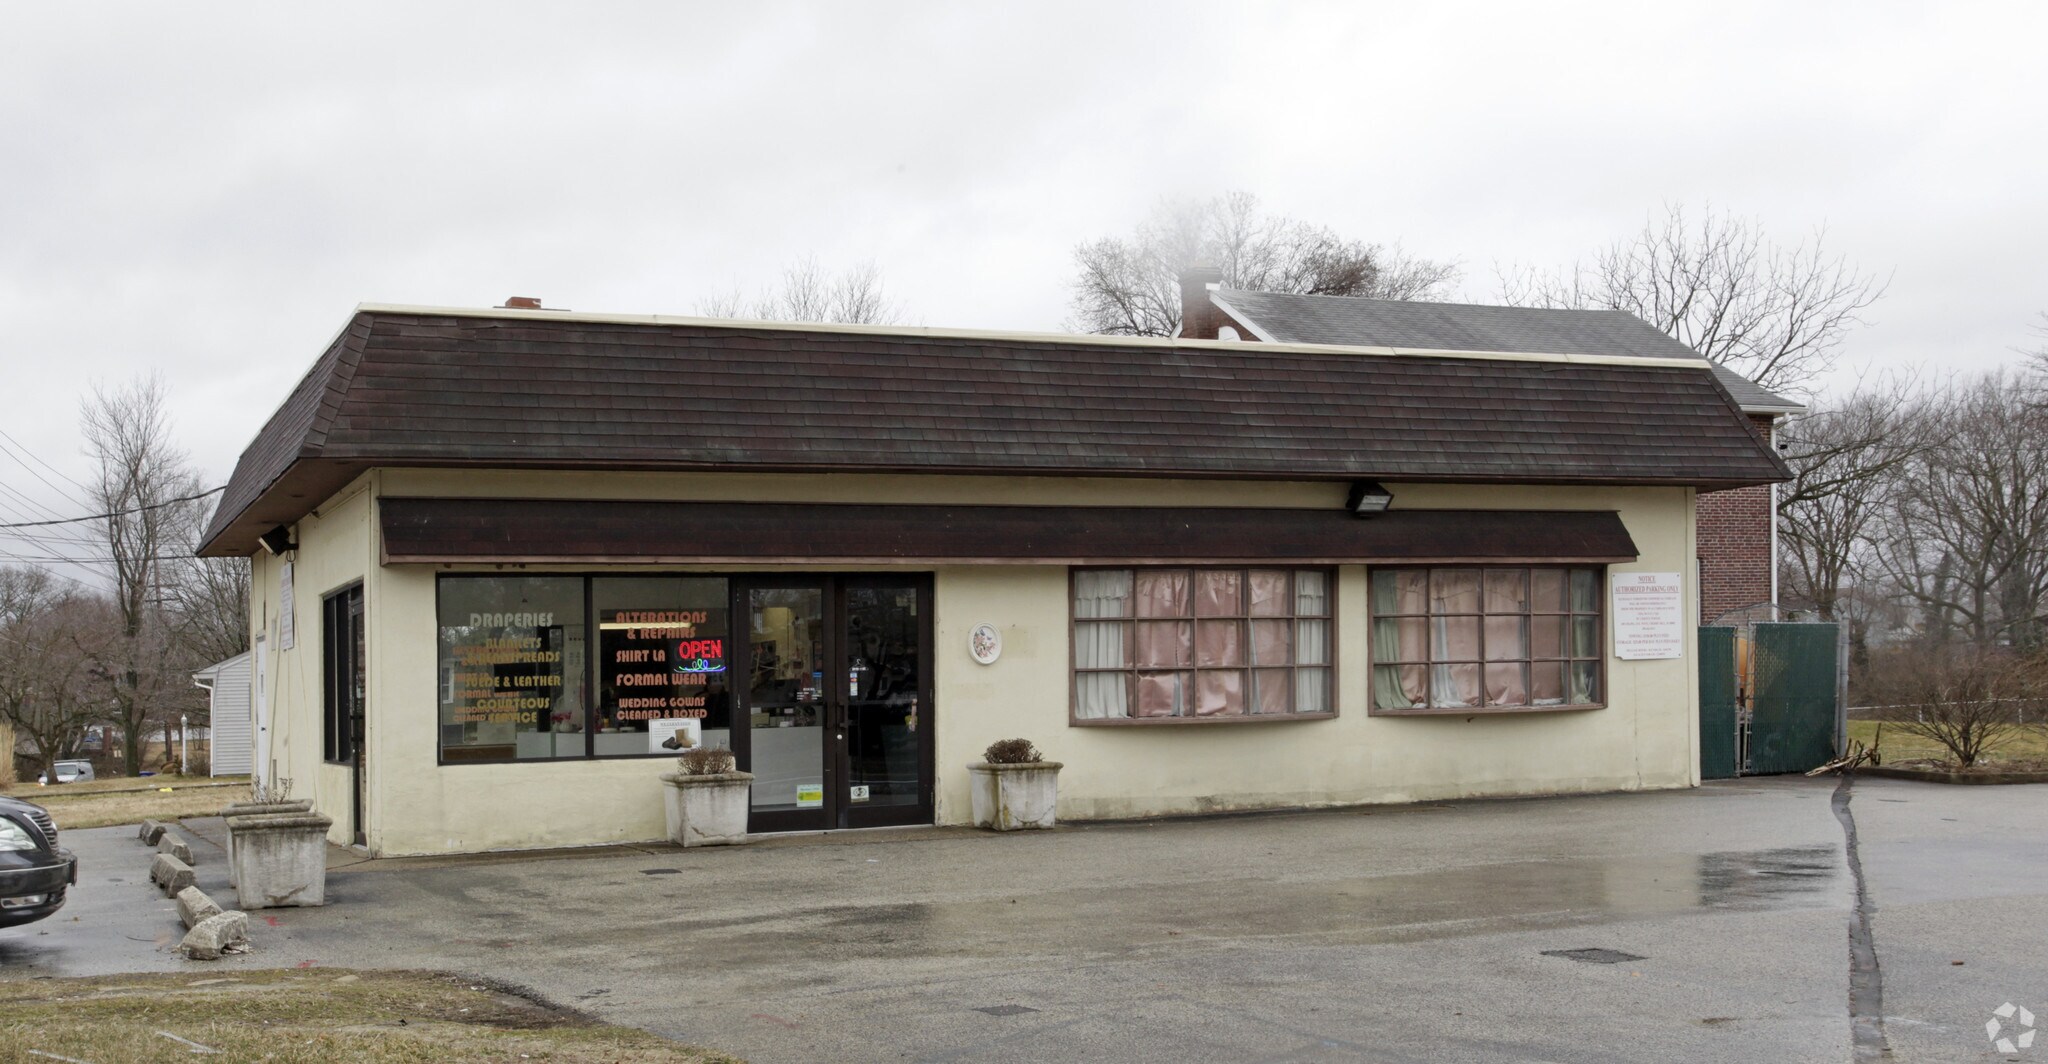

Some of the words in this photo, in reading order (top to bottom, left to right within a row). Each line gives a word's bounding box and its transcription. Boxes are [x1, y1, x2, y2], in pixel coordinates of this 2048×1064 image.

[469, 612, 554, 627] DRAPERIES
[616, 611, 707, 624] ALTERATIONS
[627, 627, 636, 640] &
[640, 626, 696, 640] REPAIRS
[679, 639, 722, 659] OPEN
[616, 649, 649, 663] SHIRT
[503, 676, 511, 688] &
[514, 675, 561, 687] LEATHER
[616, 673, 668, 686] FORMAL
[671, 672, 707, 686] WEAR
[476, 698, 550, 710] COURTEOUS
[619, 697, 666, 708] WEDDING
[669, 697, 705, 707] GOWNS
[616, 709, 661, 720] CLEANED
[664, 709, 671, 719] &
[673, 708, 708, 719] BOXED
